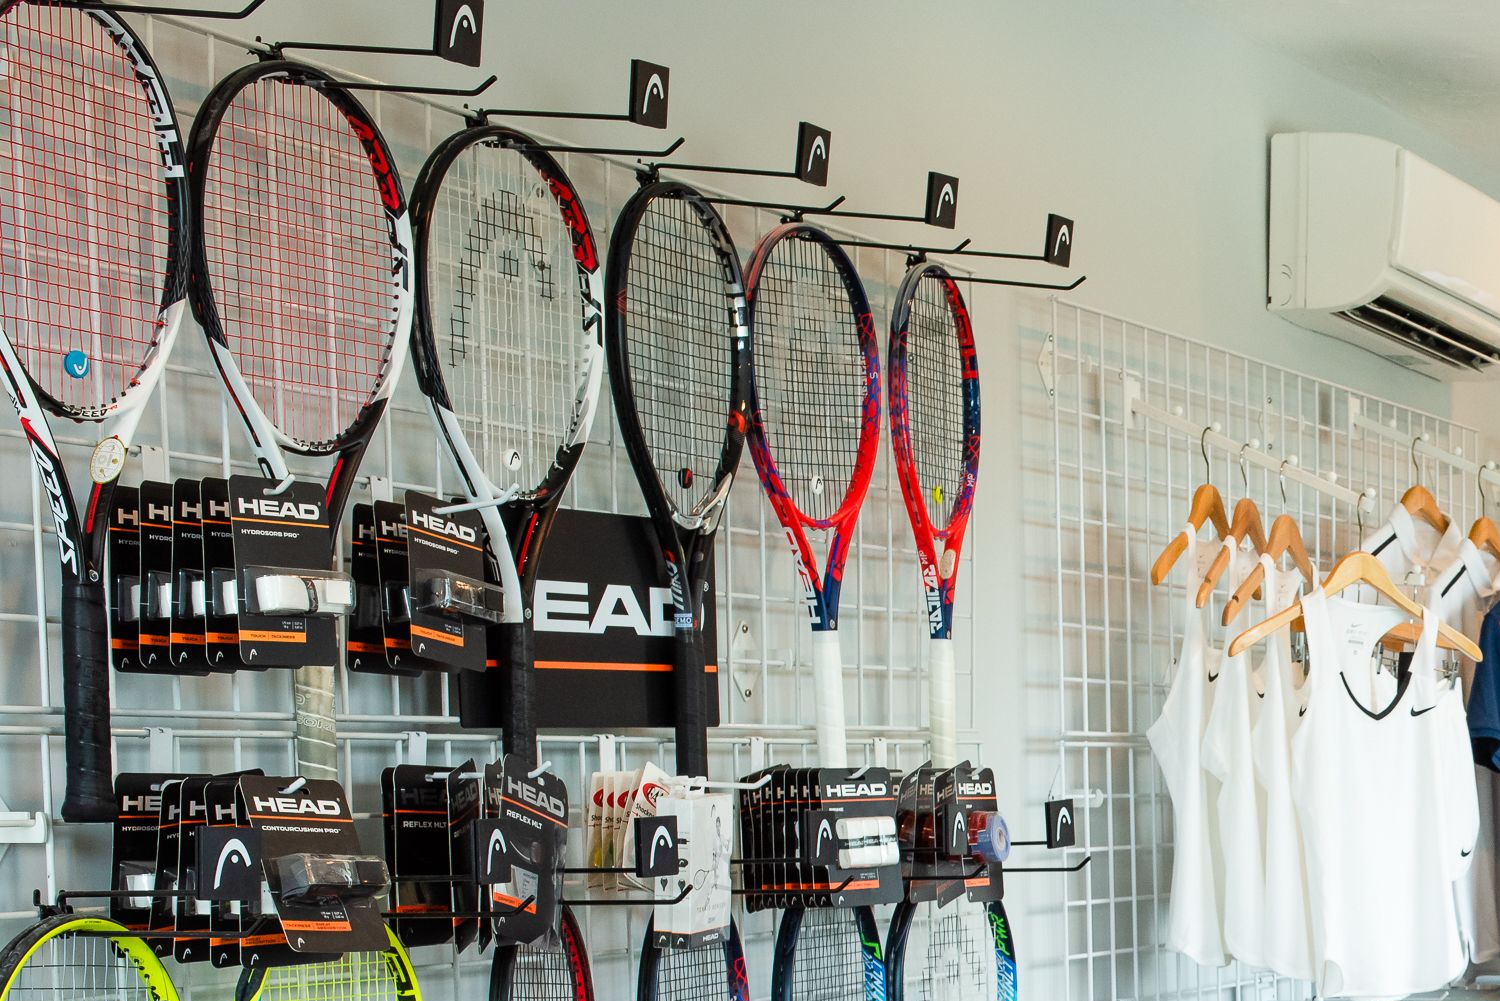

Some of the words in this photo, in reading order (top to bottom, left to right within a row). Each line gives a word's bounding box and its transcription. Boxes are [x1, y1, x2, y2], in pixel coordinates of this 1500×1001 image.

[31, 437, 78, 575] SPEED
[238, 497, 320, 521] HEAD
[241, 528, 283, 537] HYDROSORB
[382, 520, 407, 537] HE
[412, 510, 476, 543] HEAD
[533, 579, 704, 637] EAD
[827, 784, 887, 797] HEAD
[919, 784, 933, 795] HE
[958, 782, 992, 795] HEAD
[122, 795, 160, 811] HE
[507, 776, 565, 818] HEAD
[252, 796, 340, 816] HEAD
[506, 809, 532, 824] REFLEX
[261, 825, 324, 833] CONTOURCUSHION
[402, 820, 432, 829] REFLEX
[702, 933, 719, 942] HEAD
